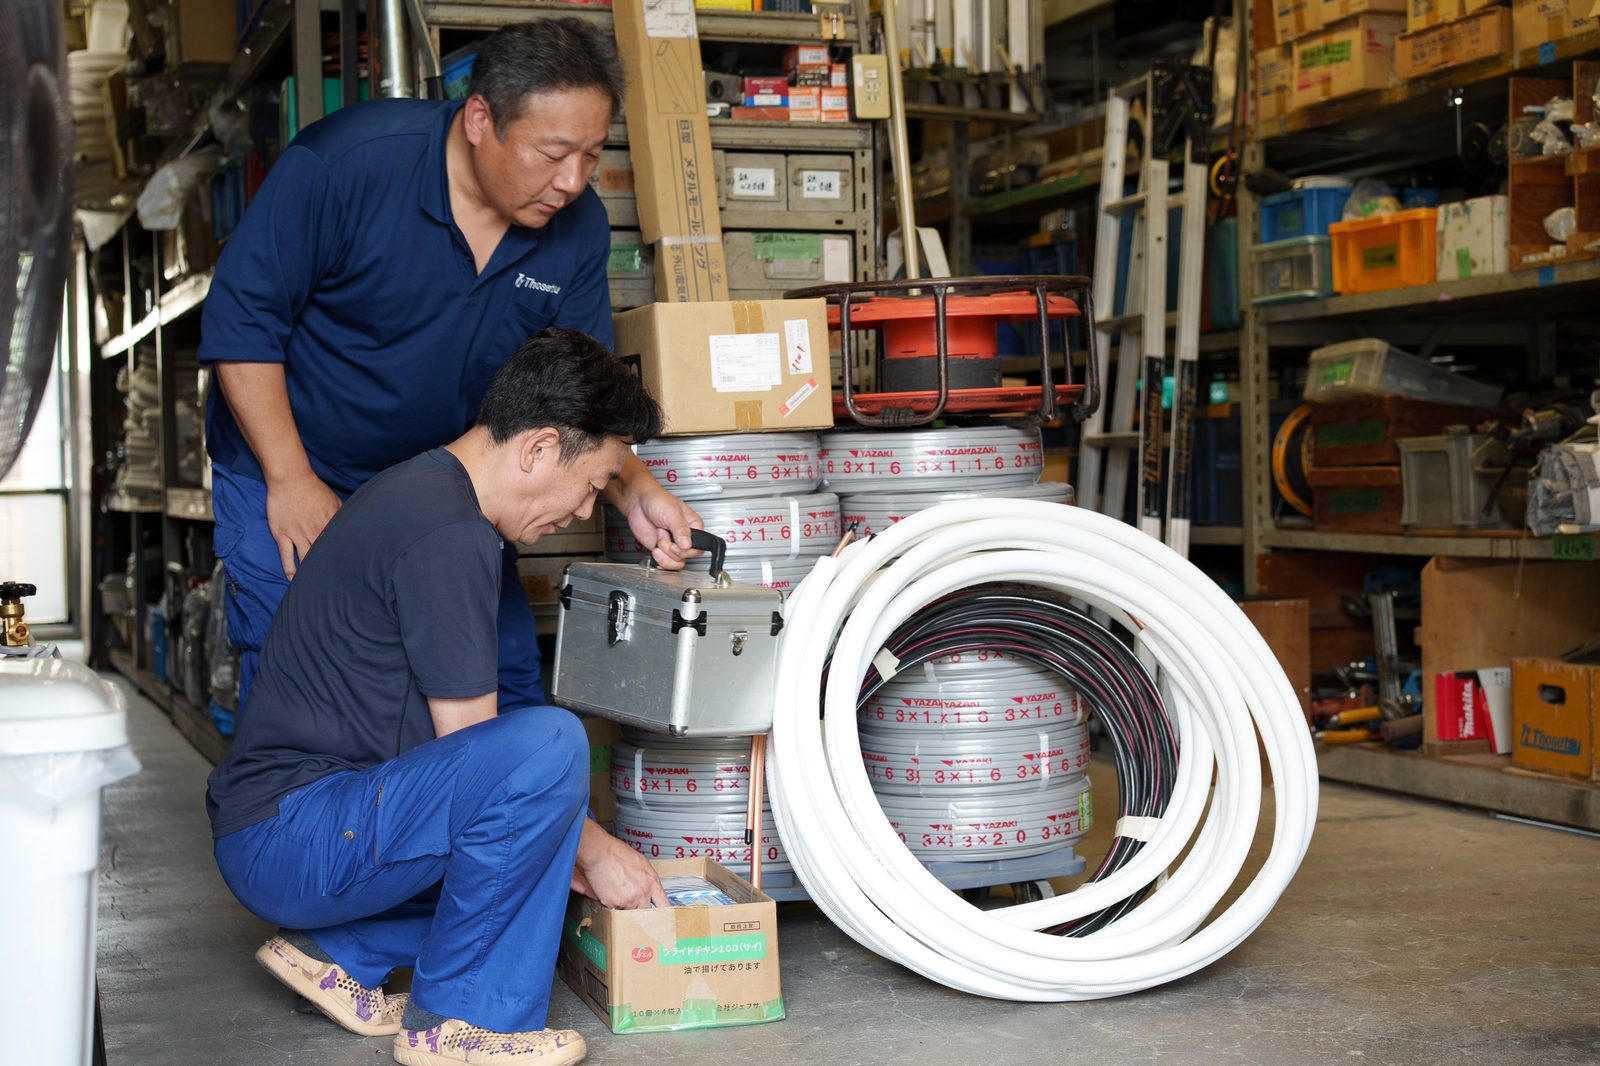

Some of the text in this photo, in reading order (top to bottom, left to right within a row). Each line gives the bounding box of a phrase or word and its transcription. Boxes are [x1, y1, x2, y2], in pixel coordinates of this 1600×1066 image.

[715, 454, 750, 462] YAZAKI
[861, 450, 893, 458] YAZAKI
[748, 515, 783, 525] YAZAKI
[1025, 693, 1056, 702] YAZAKI
[1036, 749, 1064, 758] YAZAKI
[983, 821, 1018, 830] YAZAKI
[684, 962, 761, 974] 油で揚げてあります
